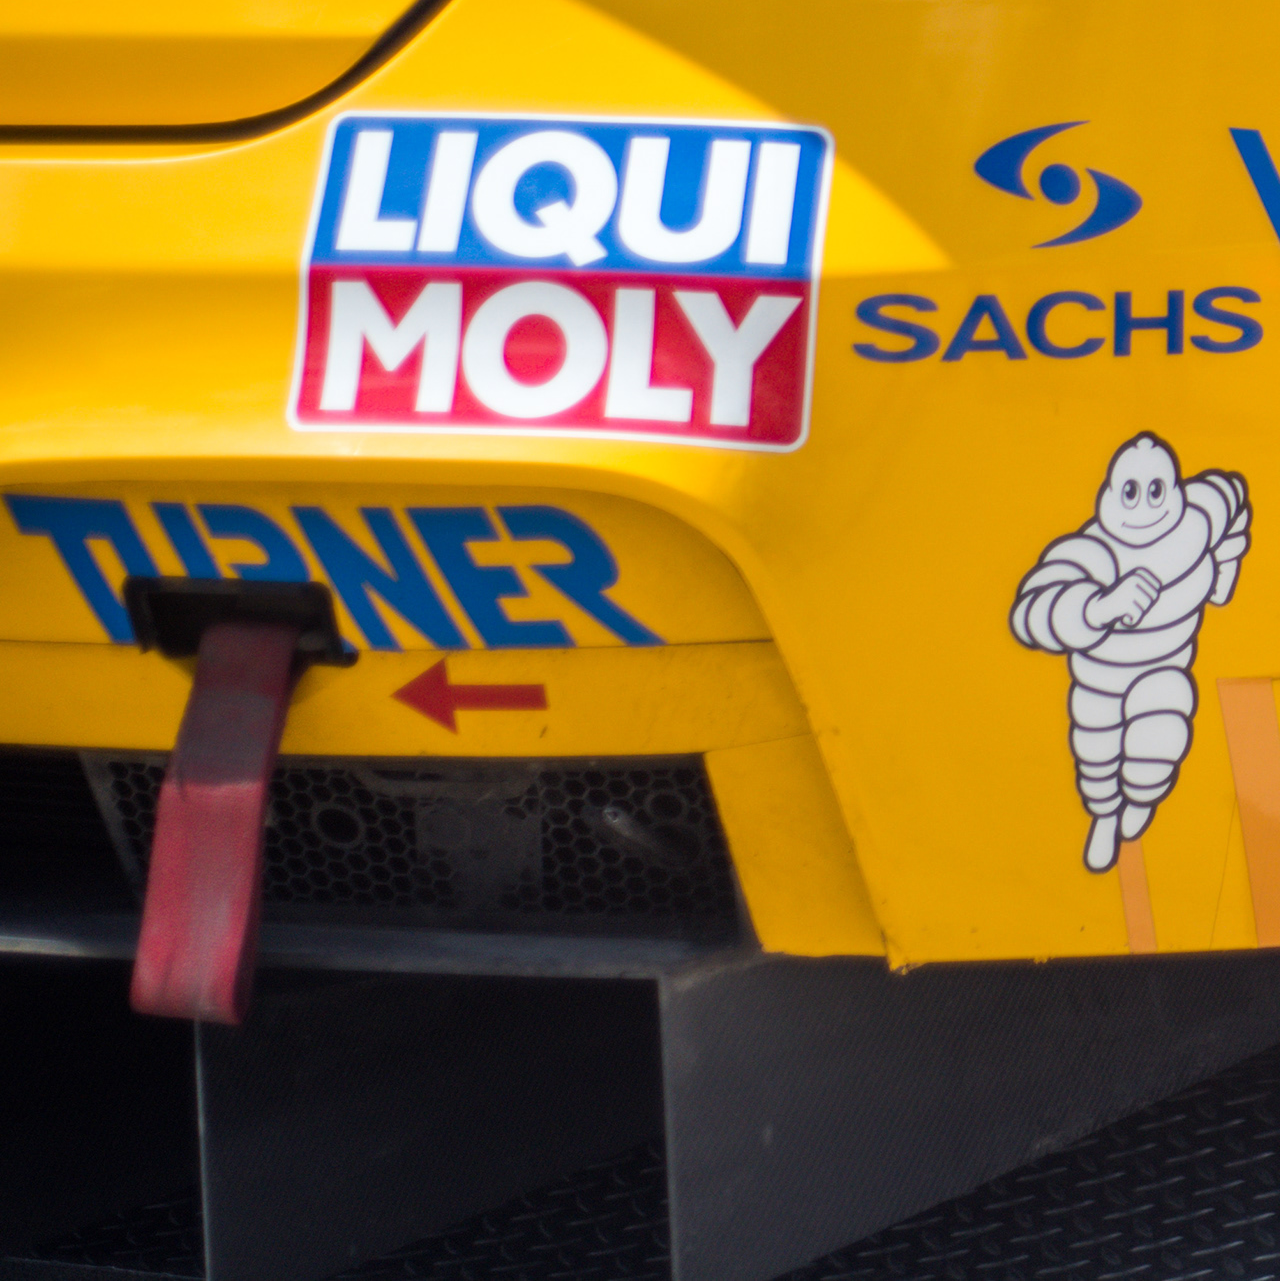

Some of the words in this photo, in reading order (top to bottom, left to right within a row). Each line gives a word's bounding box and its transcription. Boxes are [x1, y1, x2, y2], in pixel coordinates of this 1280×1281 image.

[335, 128, 802, 269] LIQUI
[319, 279, 804, 428] MOLY
[852, 285, 1265, 365] SACHS
